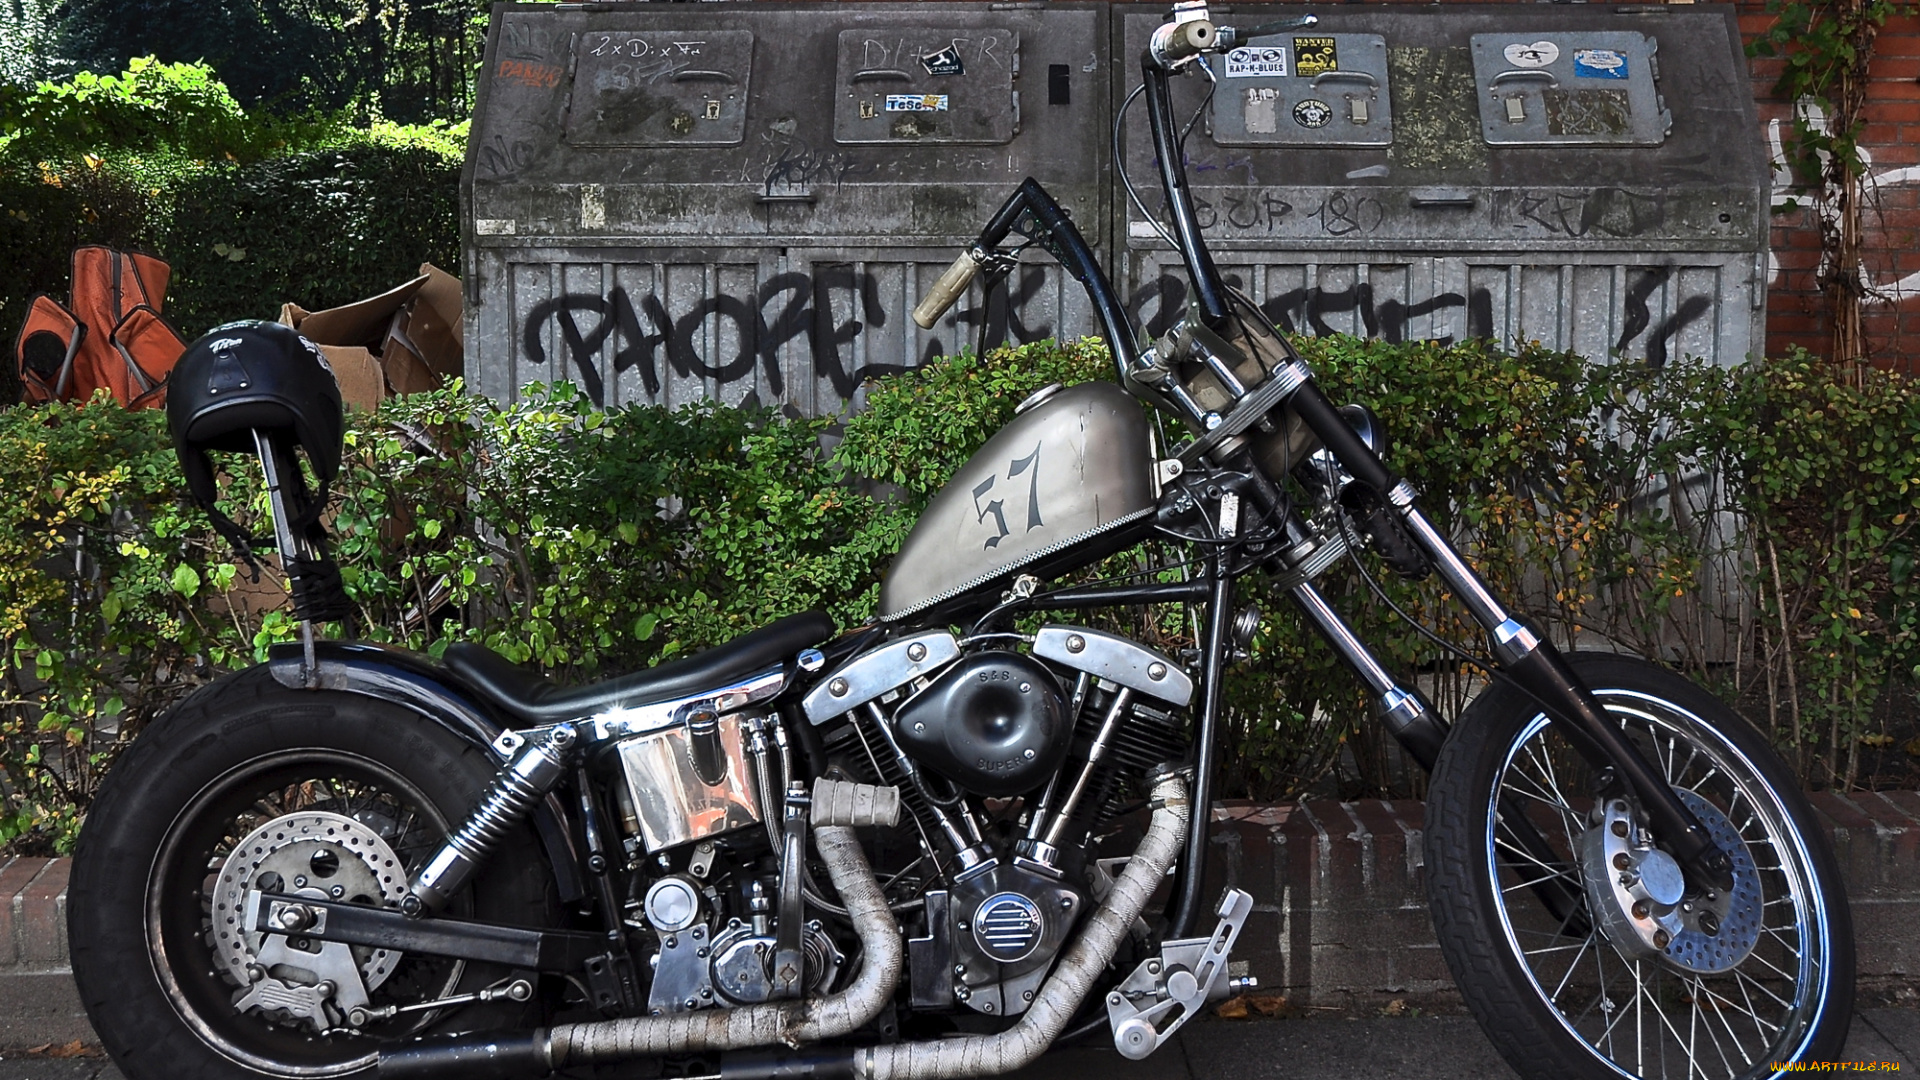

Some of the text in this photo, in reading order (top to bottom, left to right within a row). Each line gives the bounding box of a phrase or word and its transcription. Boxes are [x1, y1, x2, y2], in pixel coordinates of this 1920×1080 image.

[1307, 191, 1384, 235] 180
[972, 439, 1044, 551] 57
[977, 757, 1024, 772] SUPER
